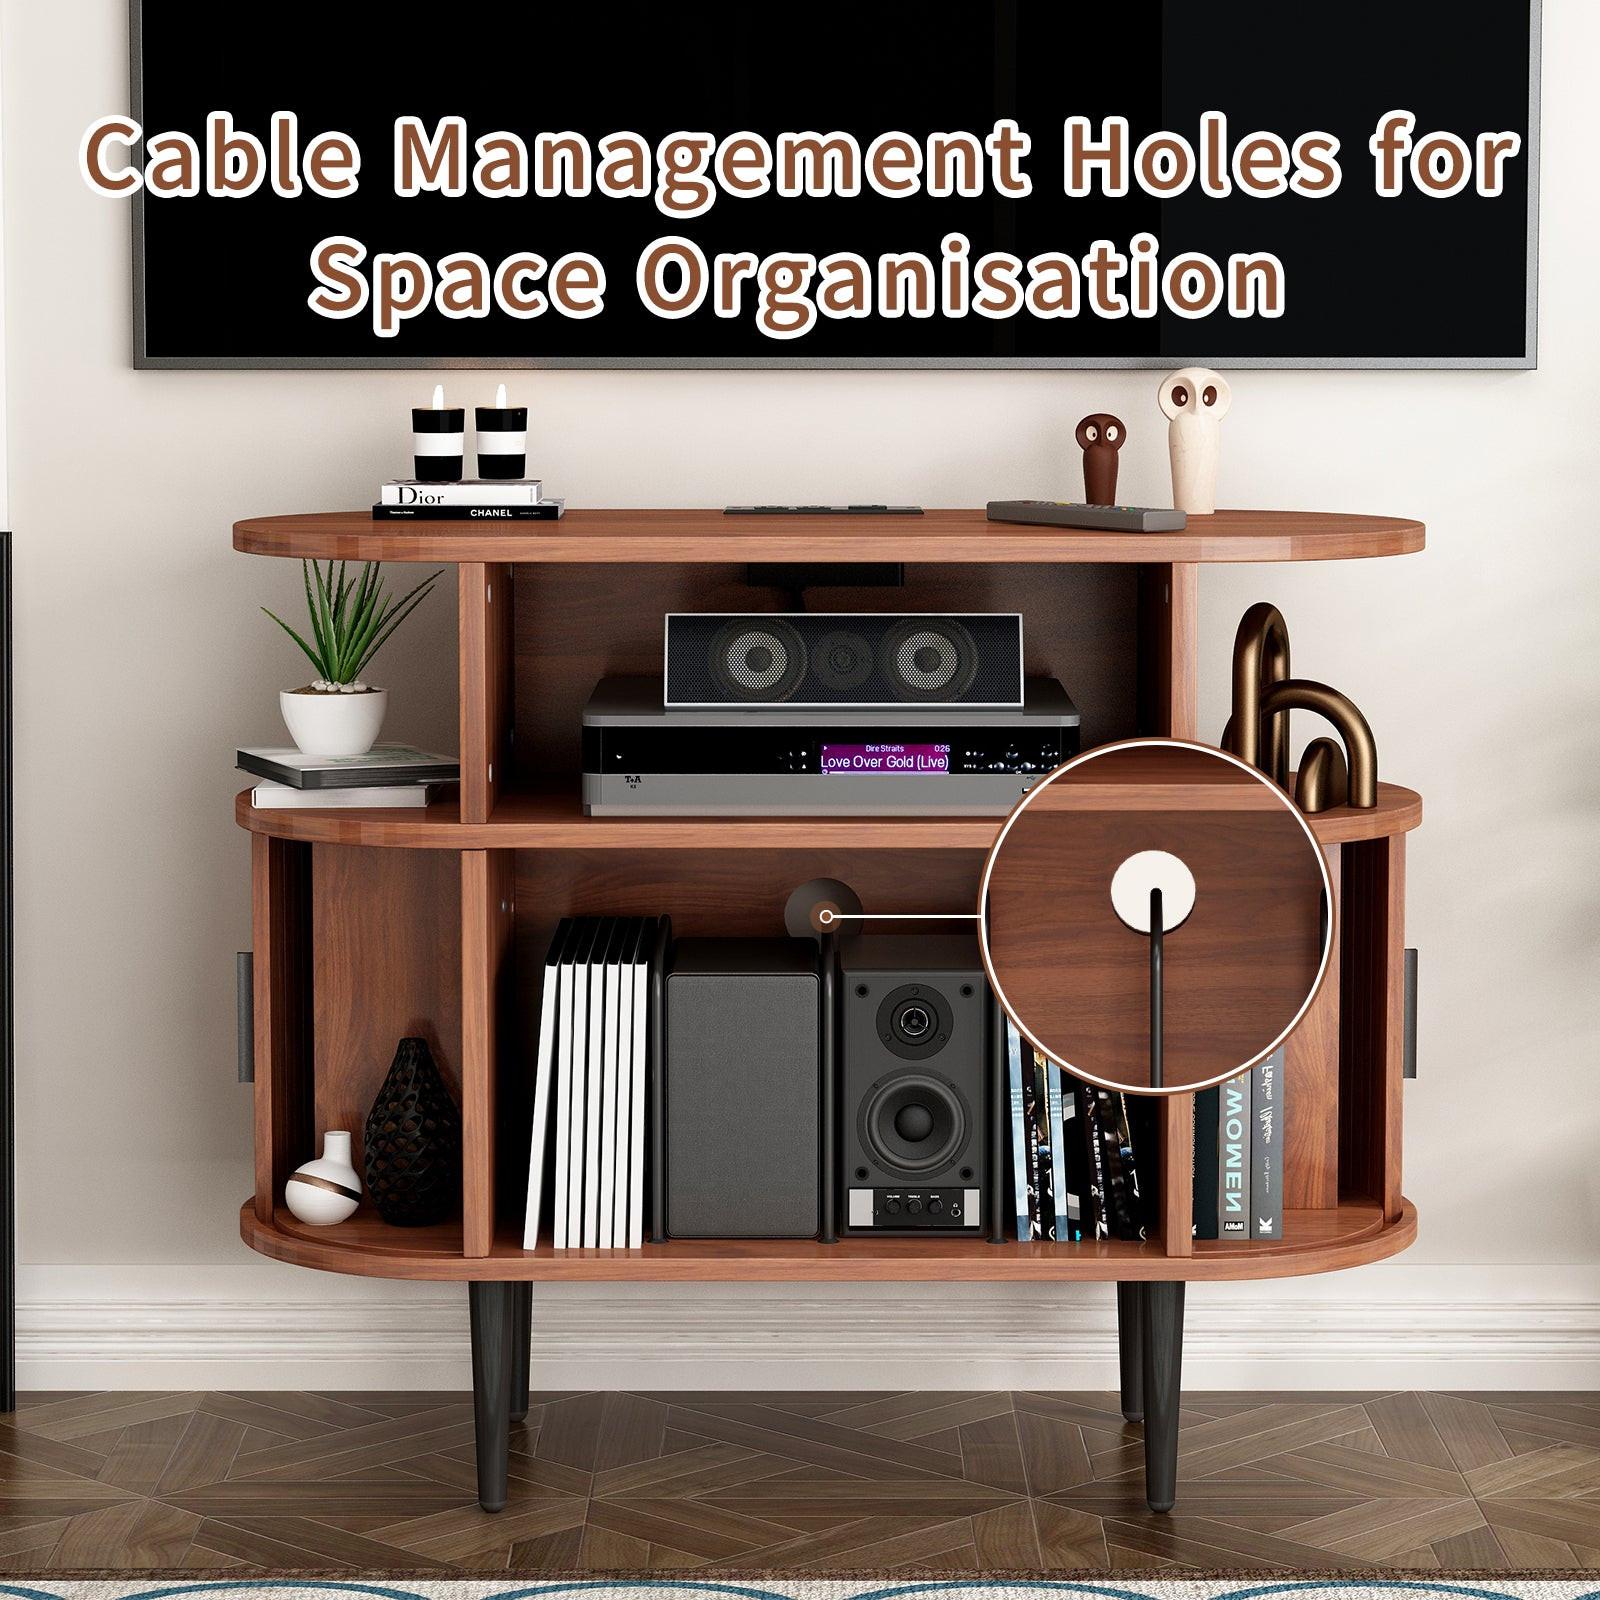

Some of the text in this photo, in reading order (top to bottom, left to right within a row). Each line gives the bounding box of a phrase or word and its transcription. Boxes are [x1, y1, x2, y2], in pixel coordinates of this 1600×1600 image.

[397, 486, 445, 505] Dior
[470, 509, 513, 517] CHANEL
[865, 744, 905, 753] Dire Straits
[820, 754, 950, 771] Love Over Gold (Live)
